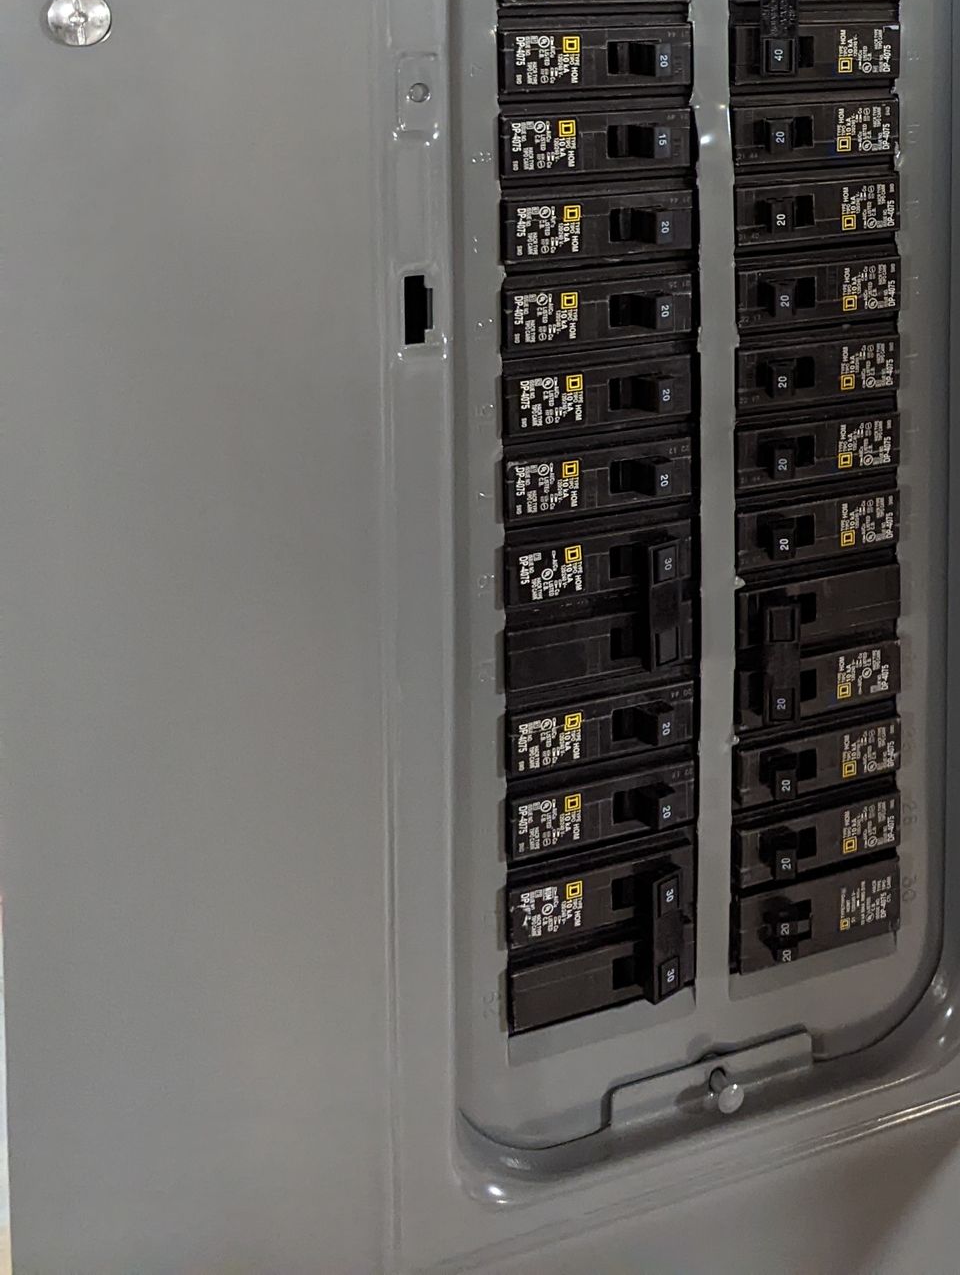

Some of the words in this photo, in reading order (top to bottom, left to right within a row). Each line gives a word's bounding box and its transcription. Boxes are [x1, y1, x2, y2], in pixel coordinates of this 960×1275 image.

[774, 48, 783, 62] 40
[659, 133, 668, 146] 15
[776, 131, 785, 143] 20
[661, 305, 670, 318] 20
[778, 376, 787, 388] 20
[664, 557, 673, 571] 30
[777, 698, 786, 711] 20
[662, 805, 671, 819] 20
[781, 858, 791, 871] 20
[665, 969, 674, 983] 30
